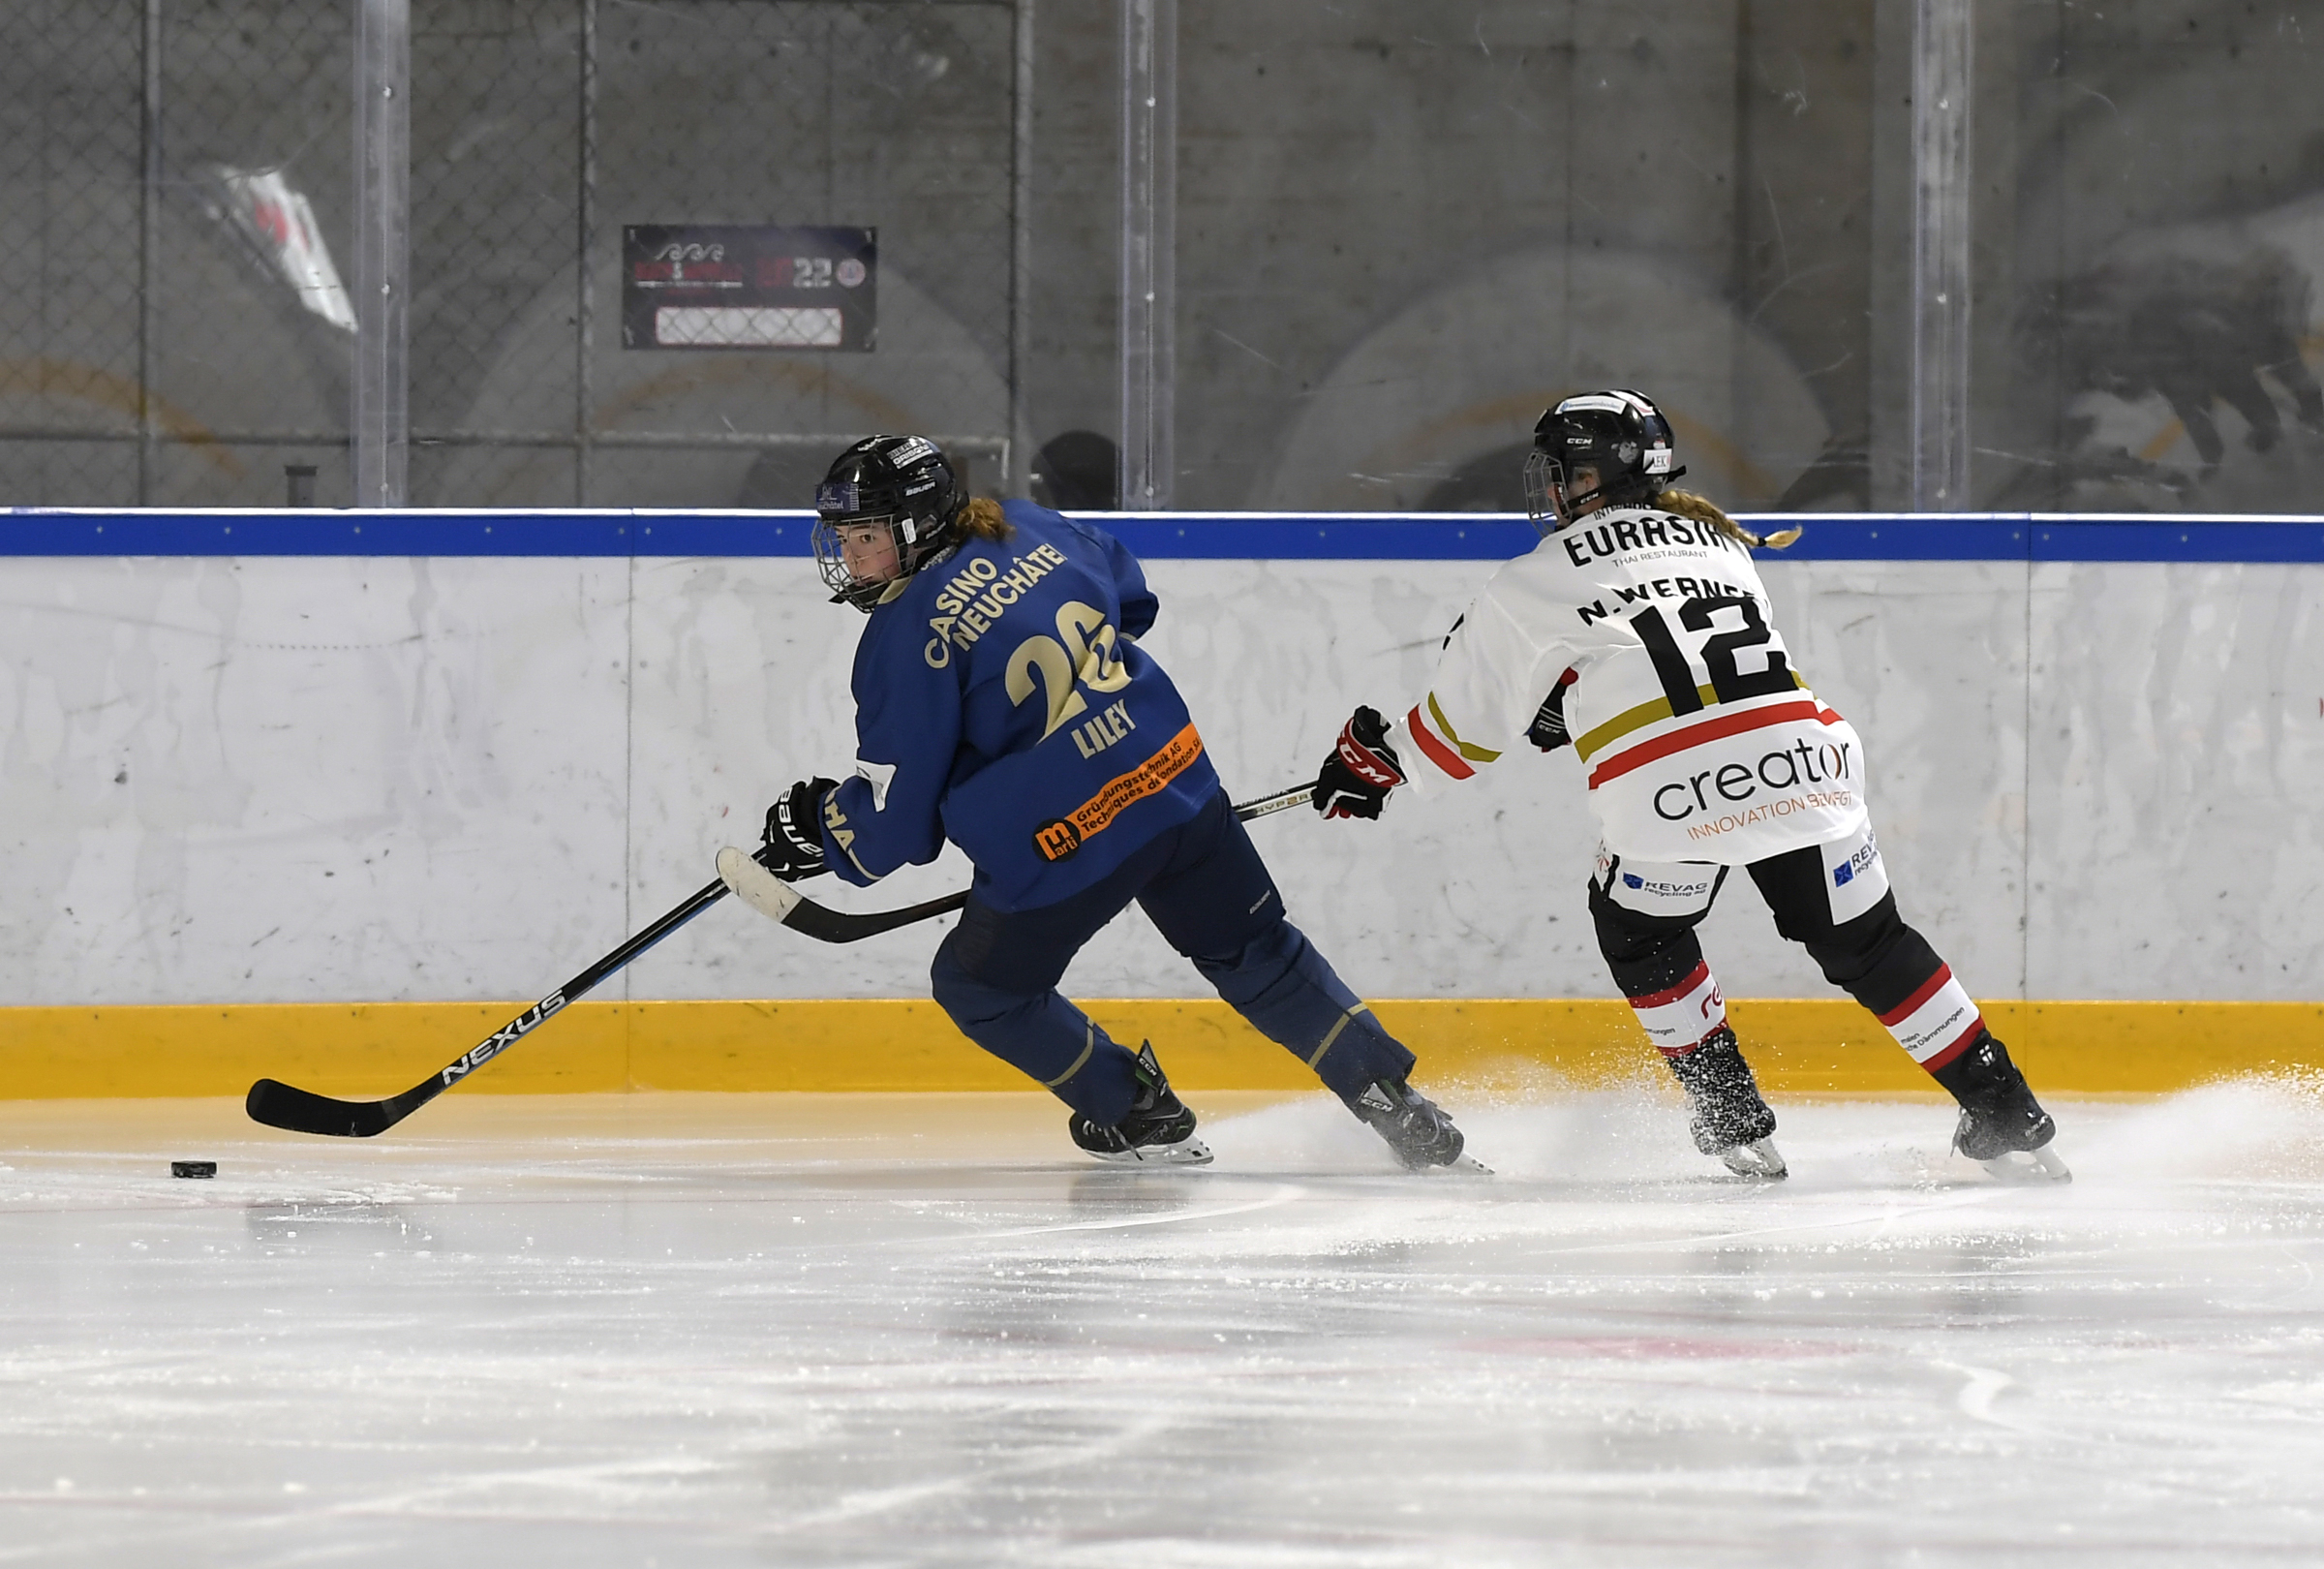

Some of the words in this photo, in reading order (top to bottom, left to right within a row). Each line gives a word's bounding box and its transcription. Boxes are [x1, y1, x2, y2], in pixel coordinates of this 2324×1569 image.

[1611, 555, 1638, 568] THAI
[1640, 550, 1707, 561] RESTAURANT
[925, 558, 997, 668] CASINO
[1005, 600, 1132, 746] 26
[1629, 597, 1799, 718] 12
[1071, 699, 1136, 759] LILEY
[1171, 742, 1181, 757] AG
[1338, 730, 1391, 783] CM
[1654, 738, 1850, 820] creator
[1688, 796, 1805, 840] INNOVATION
[1645, 881, 1708, 891] REVAG
[443, 989, 566, 1086] NEXUS
[1138, 1058, 1157, 1076] CCM
